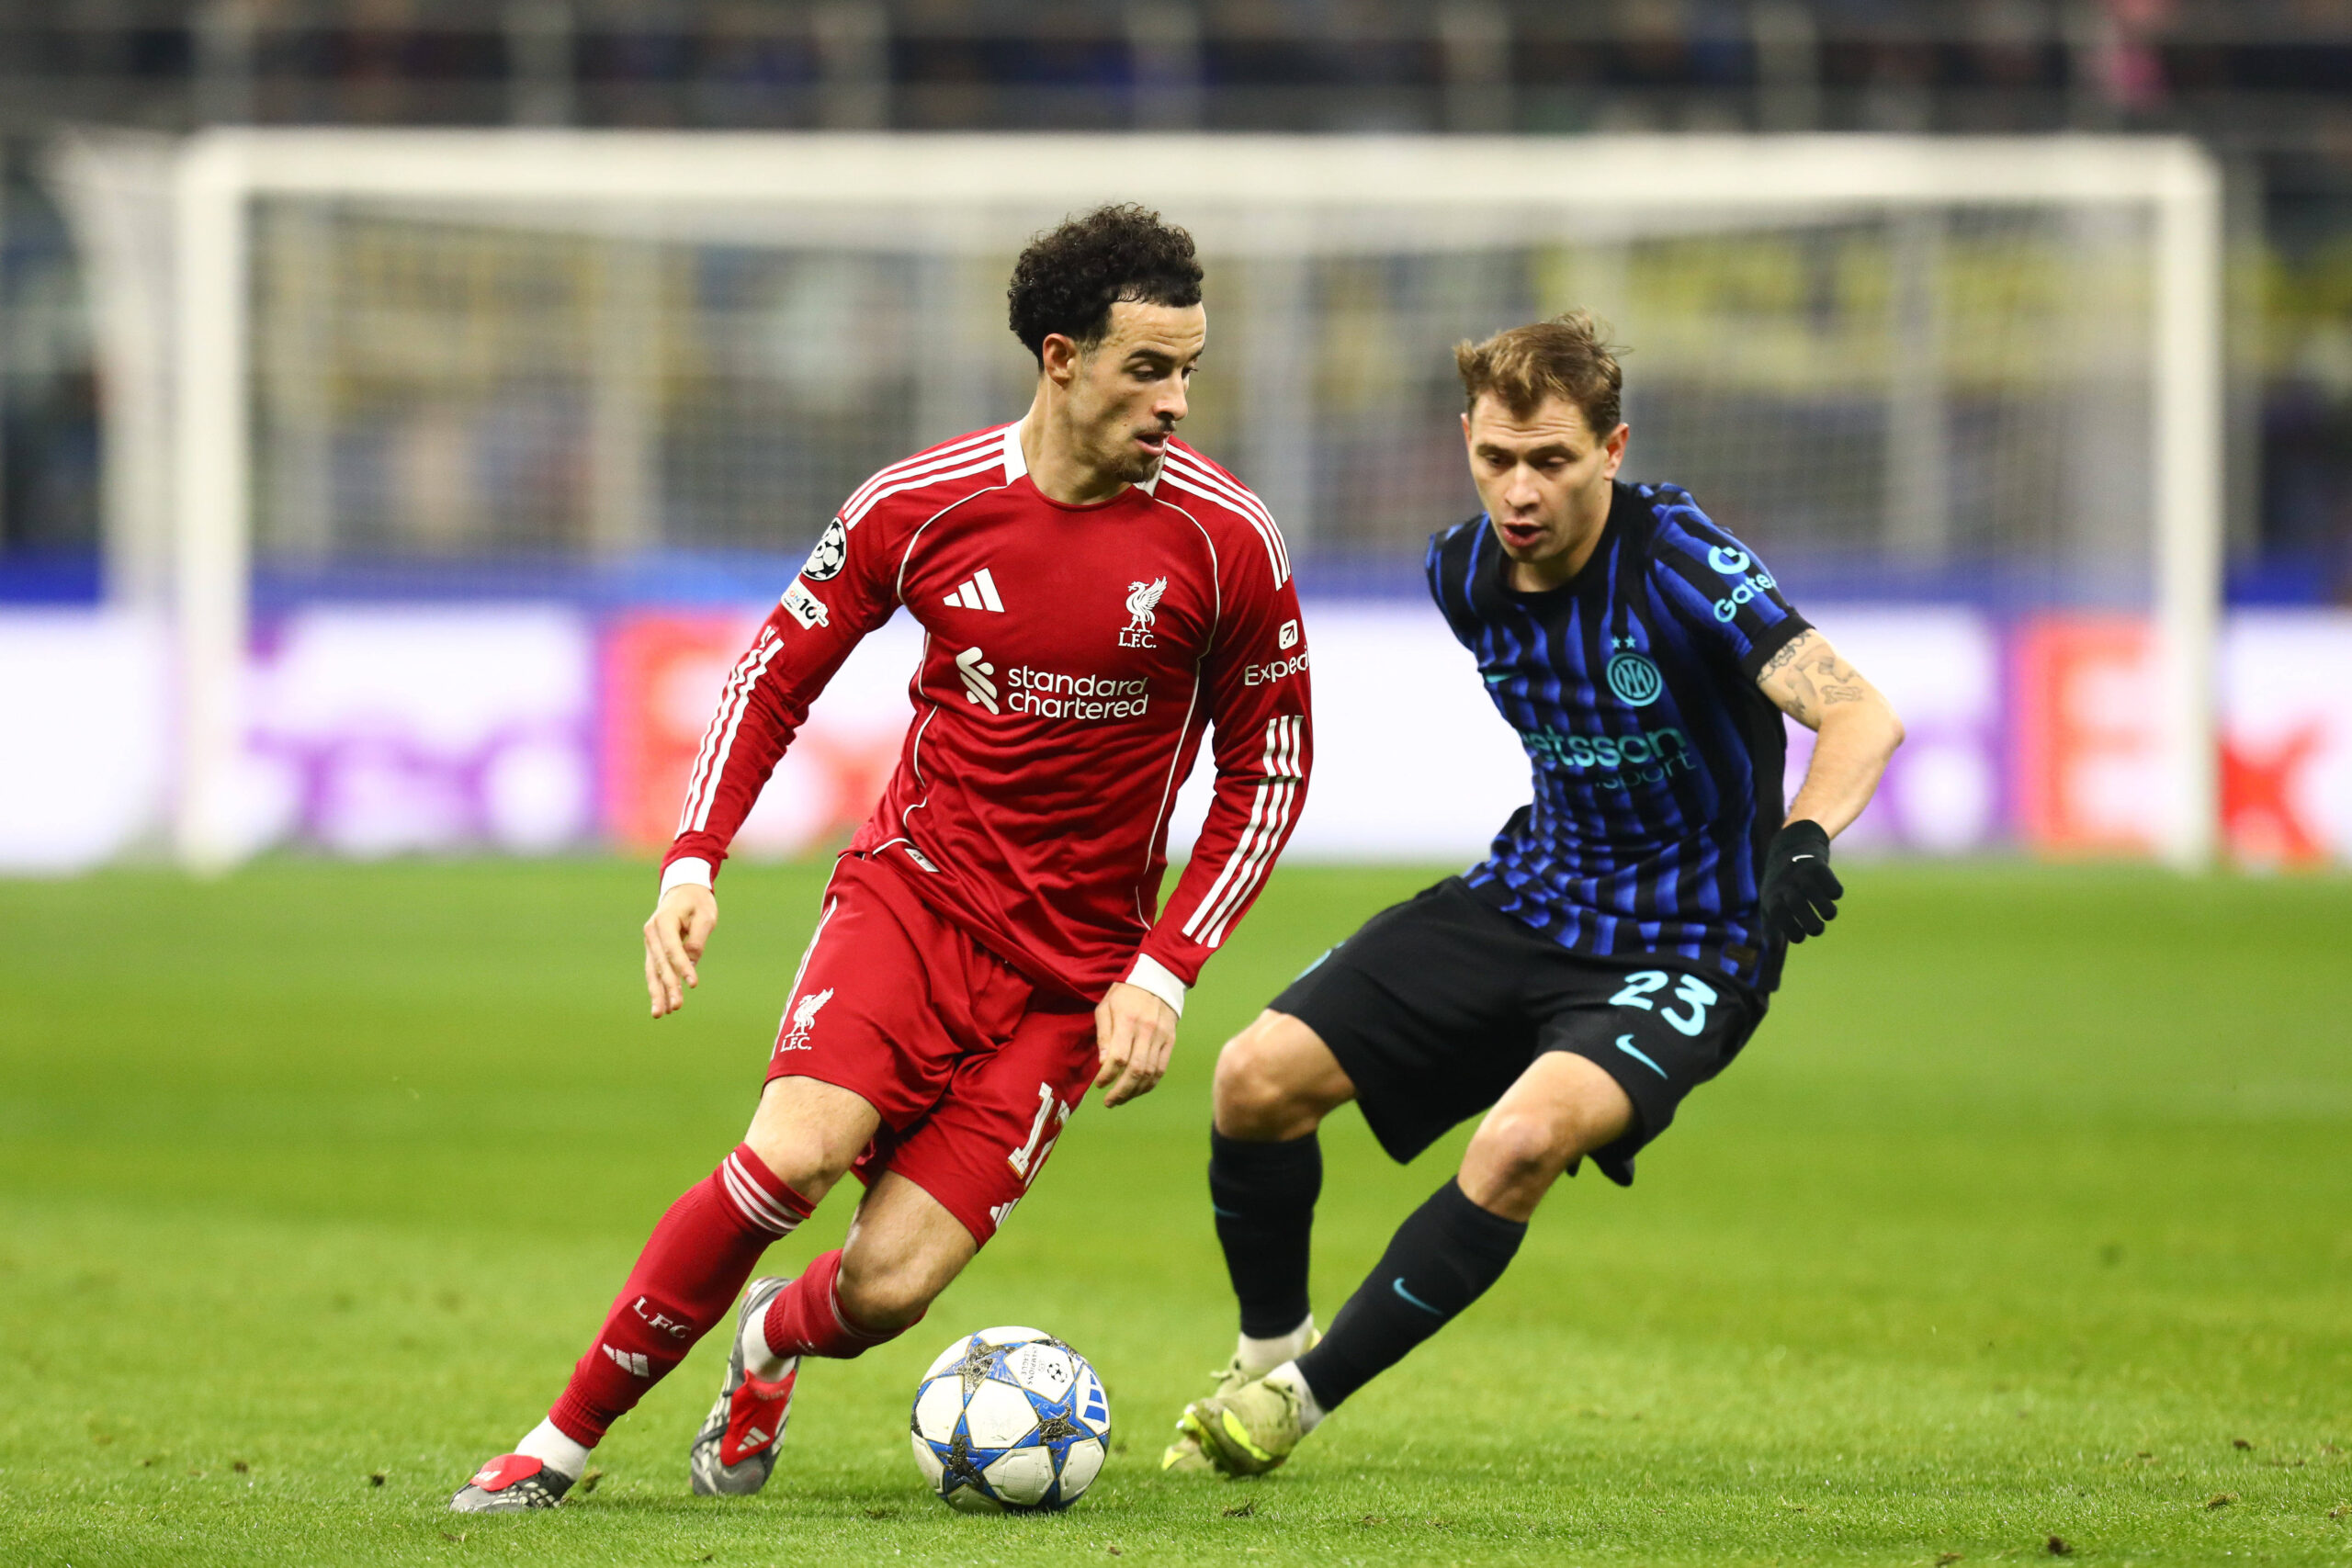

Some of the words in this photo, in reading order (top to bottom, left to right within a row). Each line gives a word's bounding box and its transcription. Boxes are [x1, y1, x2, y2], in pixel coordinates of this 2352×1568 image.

[1118, 631, 1157, 649] L.F.C.
[1008, 665, 1148, 696] standard
[1008, 689, 1148, 719] chartered
[1521, 724, 1687, 767] etsson
[1608, 970, 1718, 1037] 23
[633, 1296, 691, 1338] LFC
